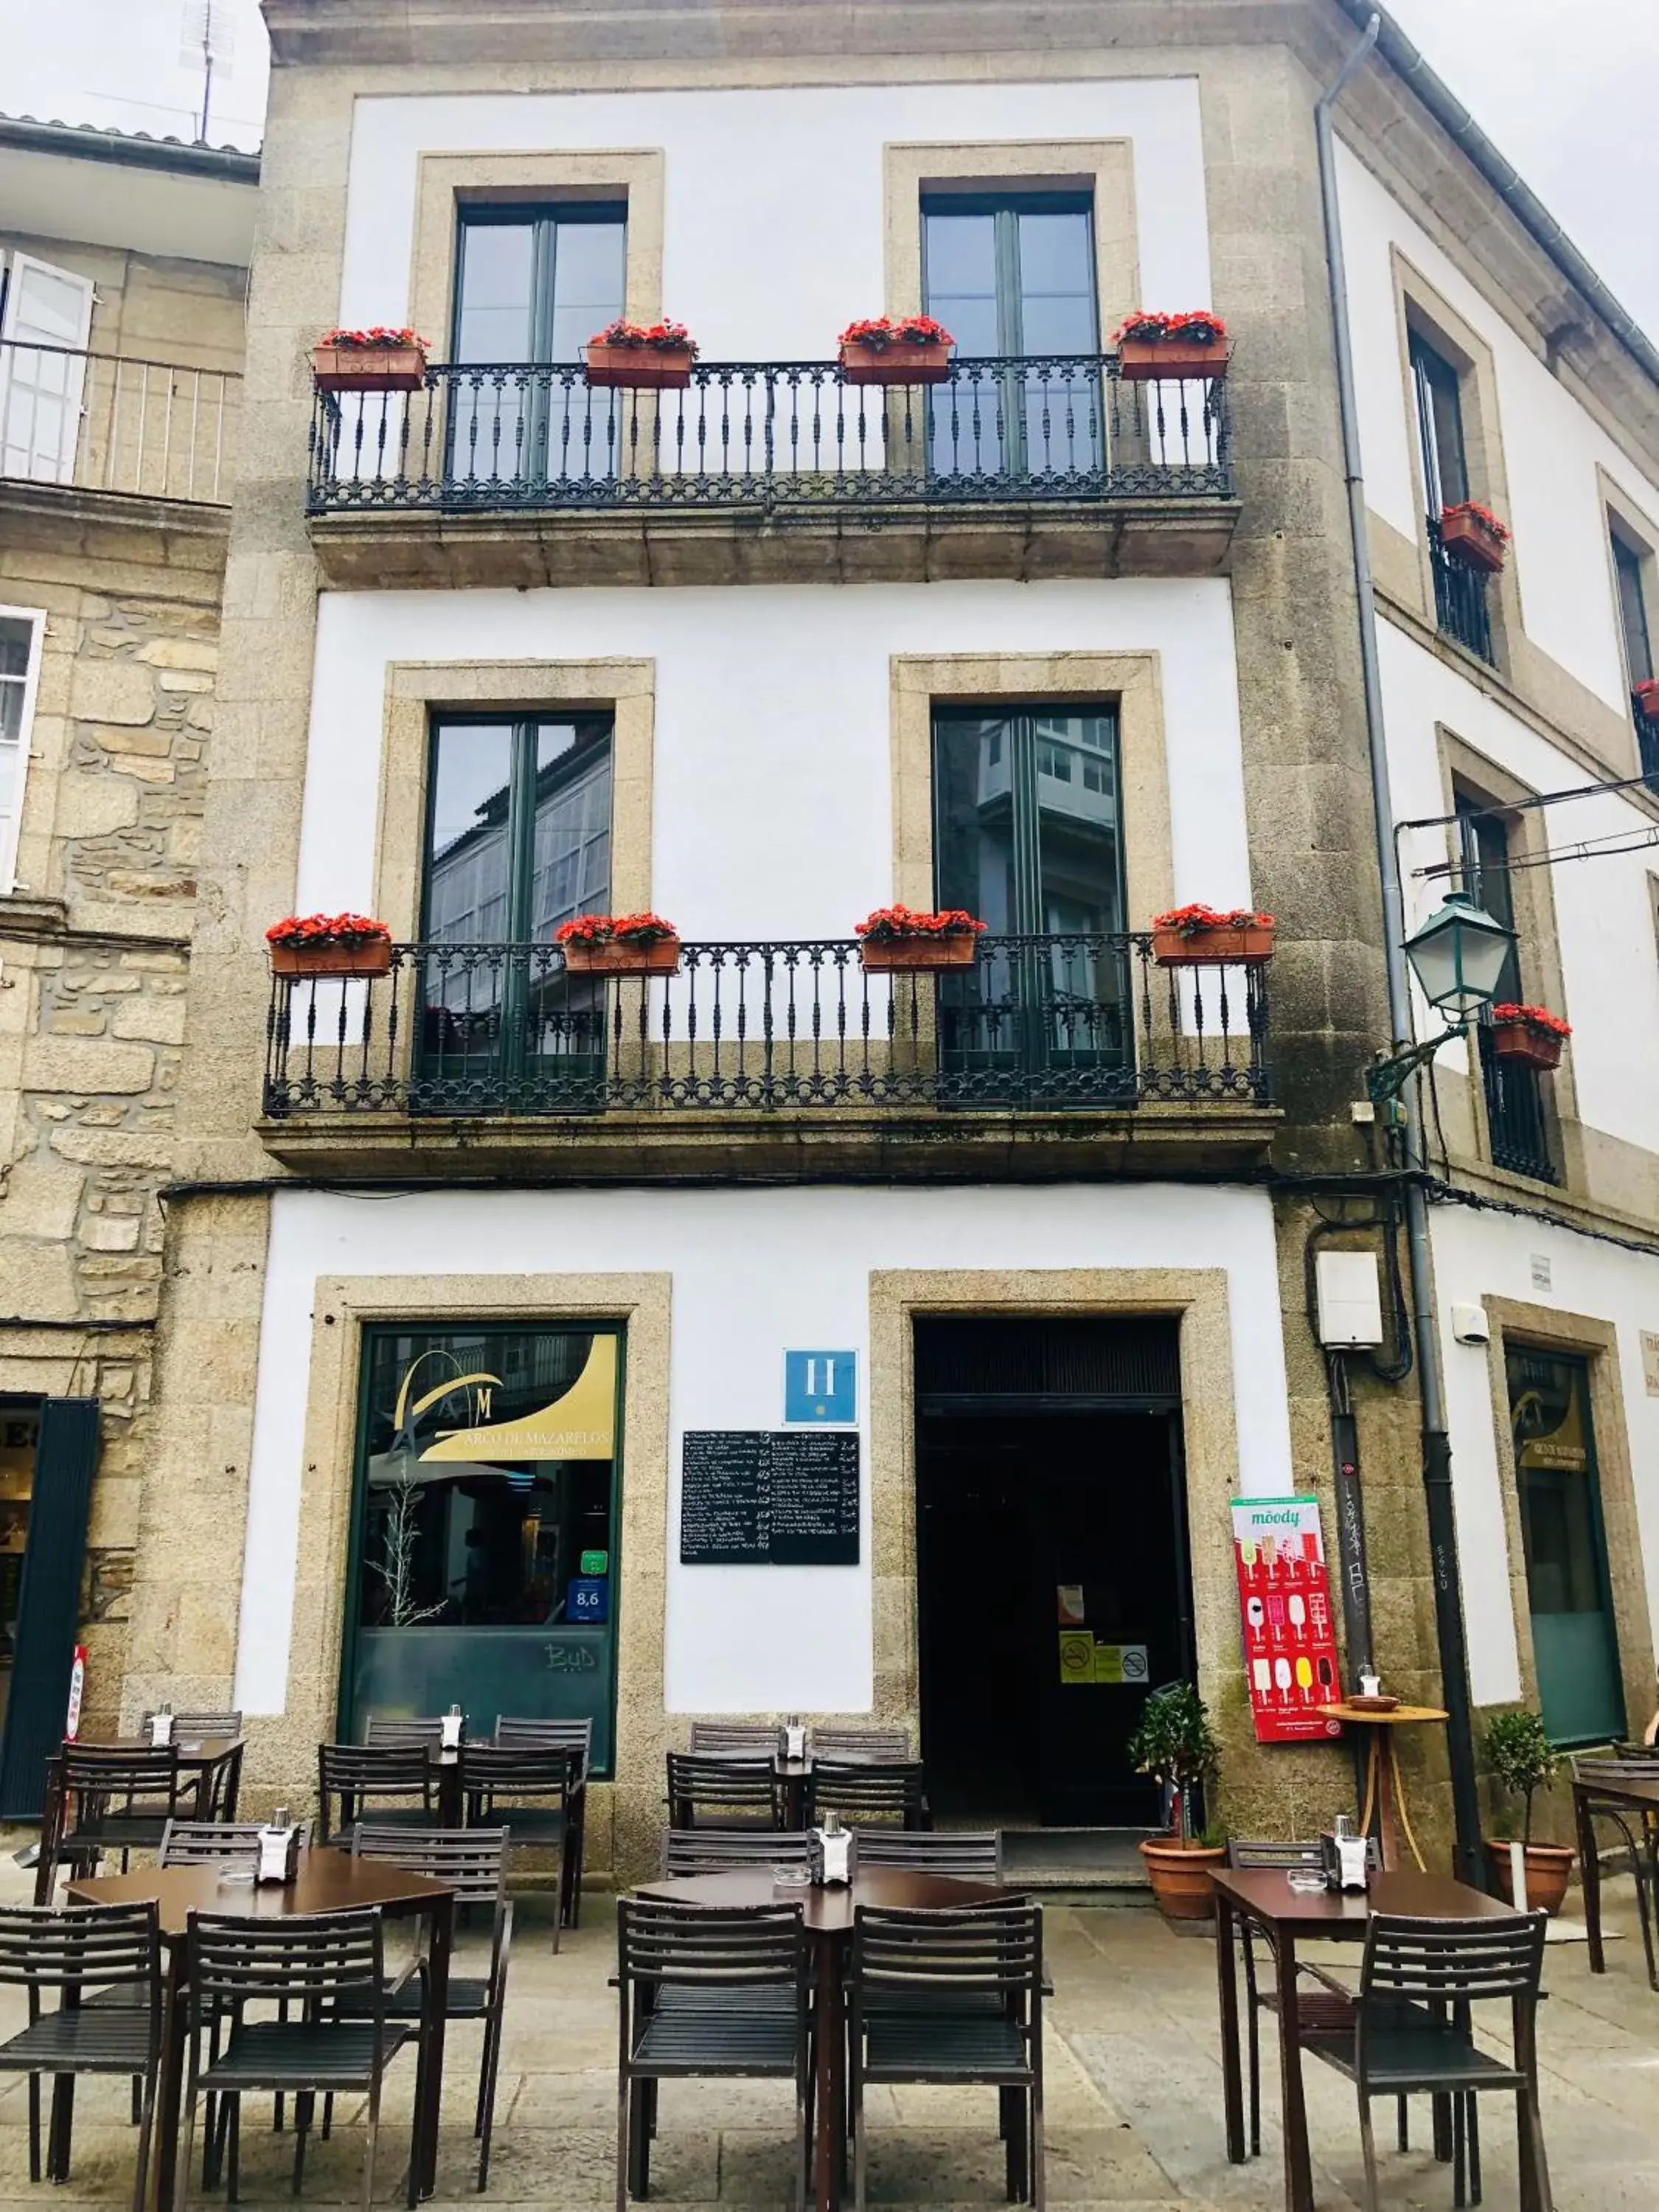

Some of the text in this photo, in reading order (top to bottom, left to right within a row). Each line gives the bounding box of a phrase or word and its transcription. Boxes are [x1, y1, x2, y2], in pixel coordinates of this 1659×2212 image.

[804, 1358, 837, 1396] H
[476, 1388, 492, 1426] M
[465, 1430, 609, 1445] ARCO DE MAZARELOS
[577, 1592, 599, 1607] 8,6
